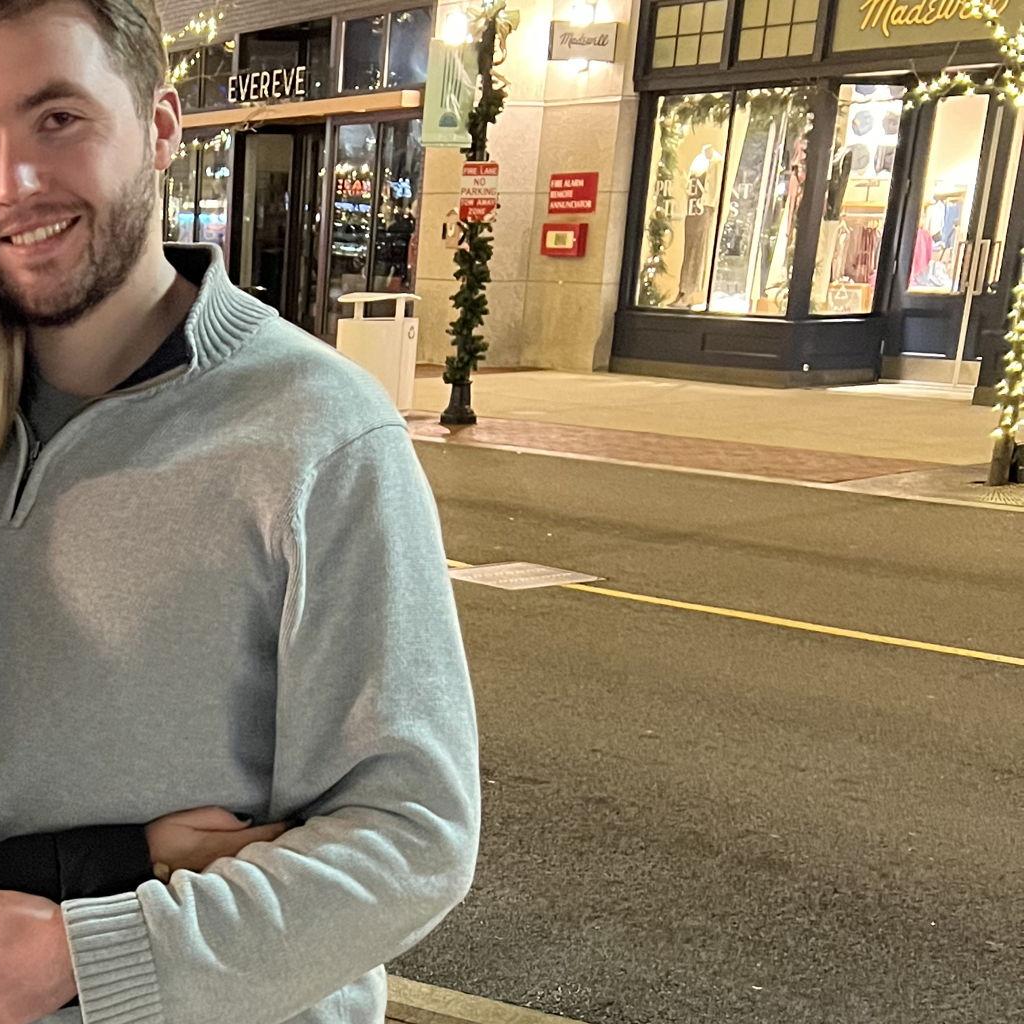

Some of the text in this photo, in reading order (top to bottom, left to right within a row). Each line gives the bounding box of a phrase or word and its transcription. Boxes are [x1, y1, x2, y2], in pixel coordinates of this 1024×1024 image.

[859, 0, 1010, 37] Madew
[228, 66, 306, 103] EVEREVE
[474, 177, 486, 186] NO
[563, 178, 585, 188] ALARM
[461, 187, 497, 196] PARKING
